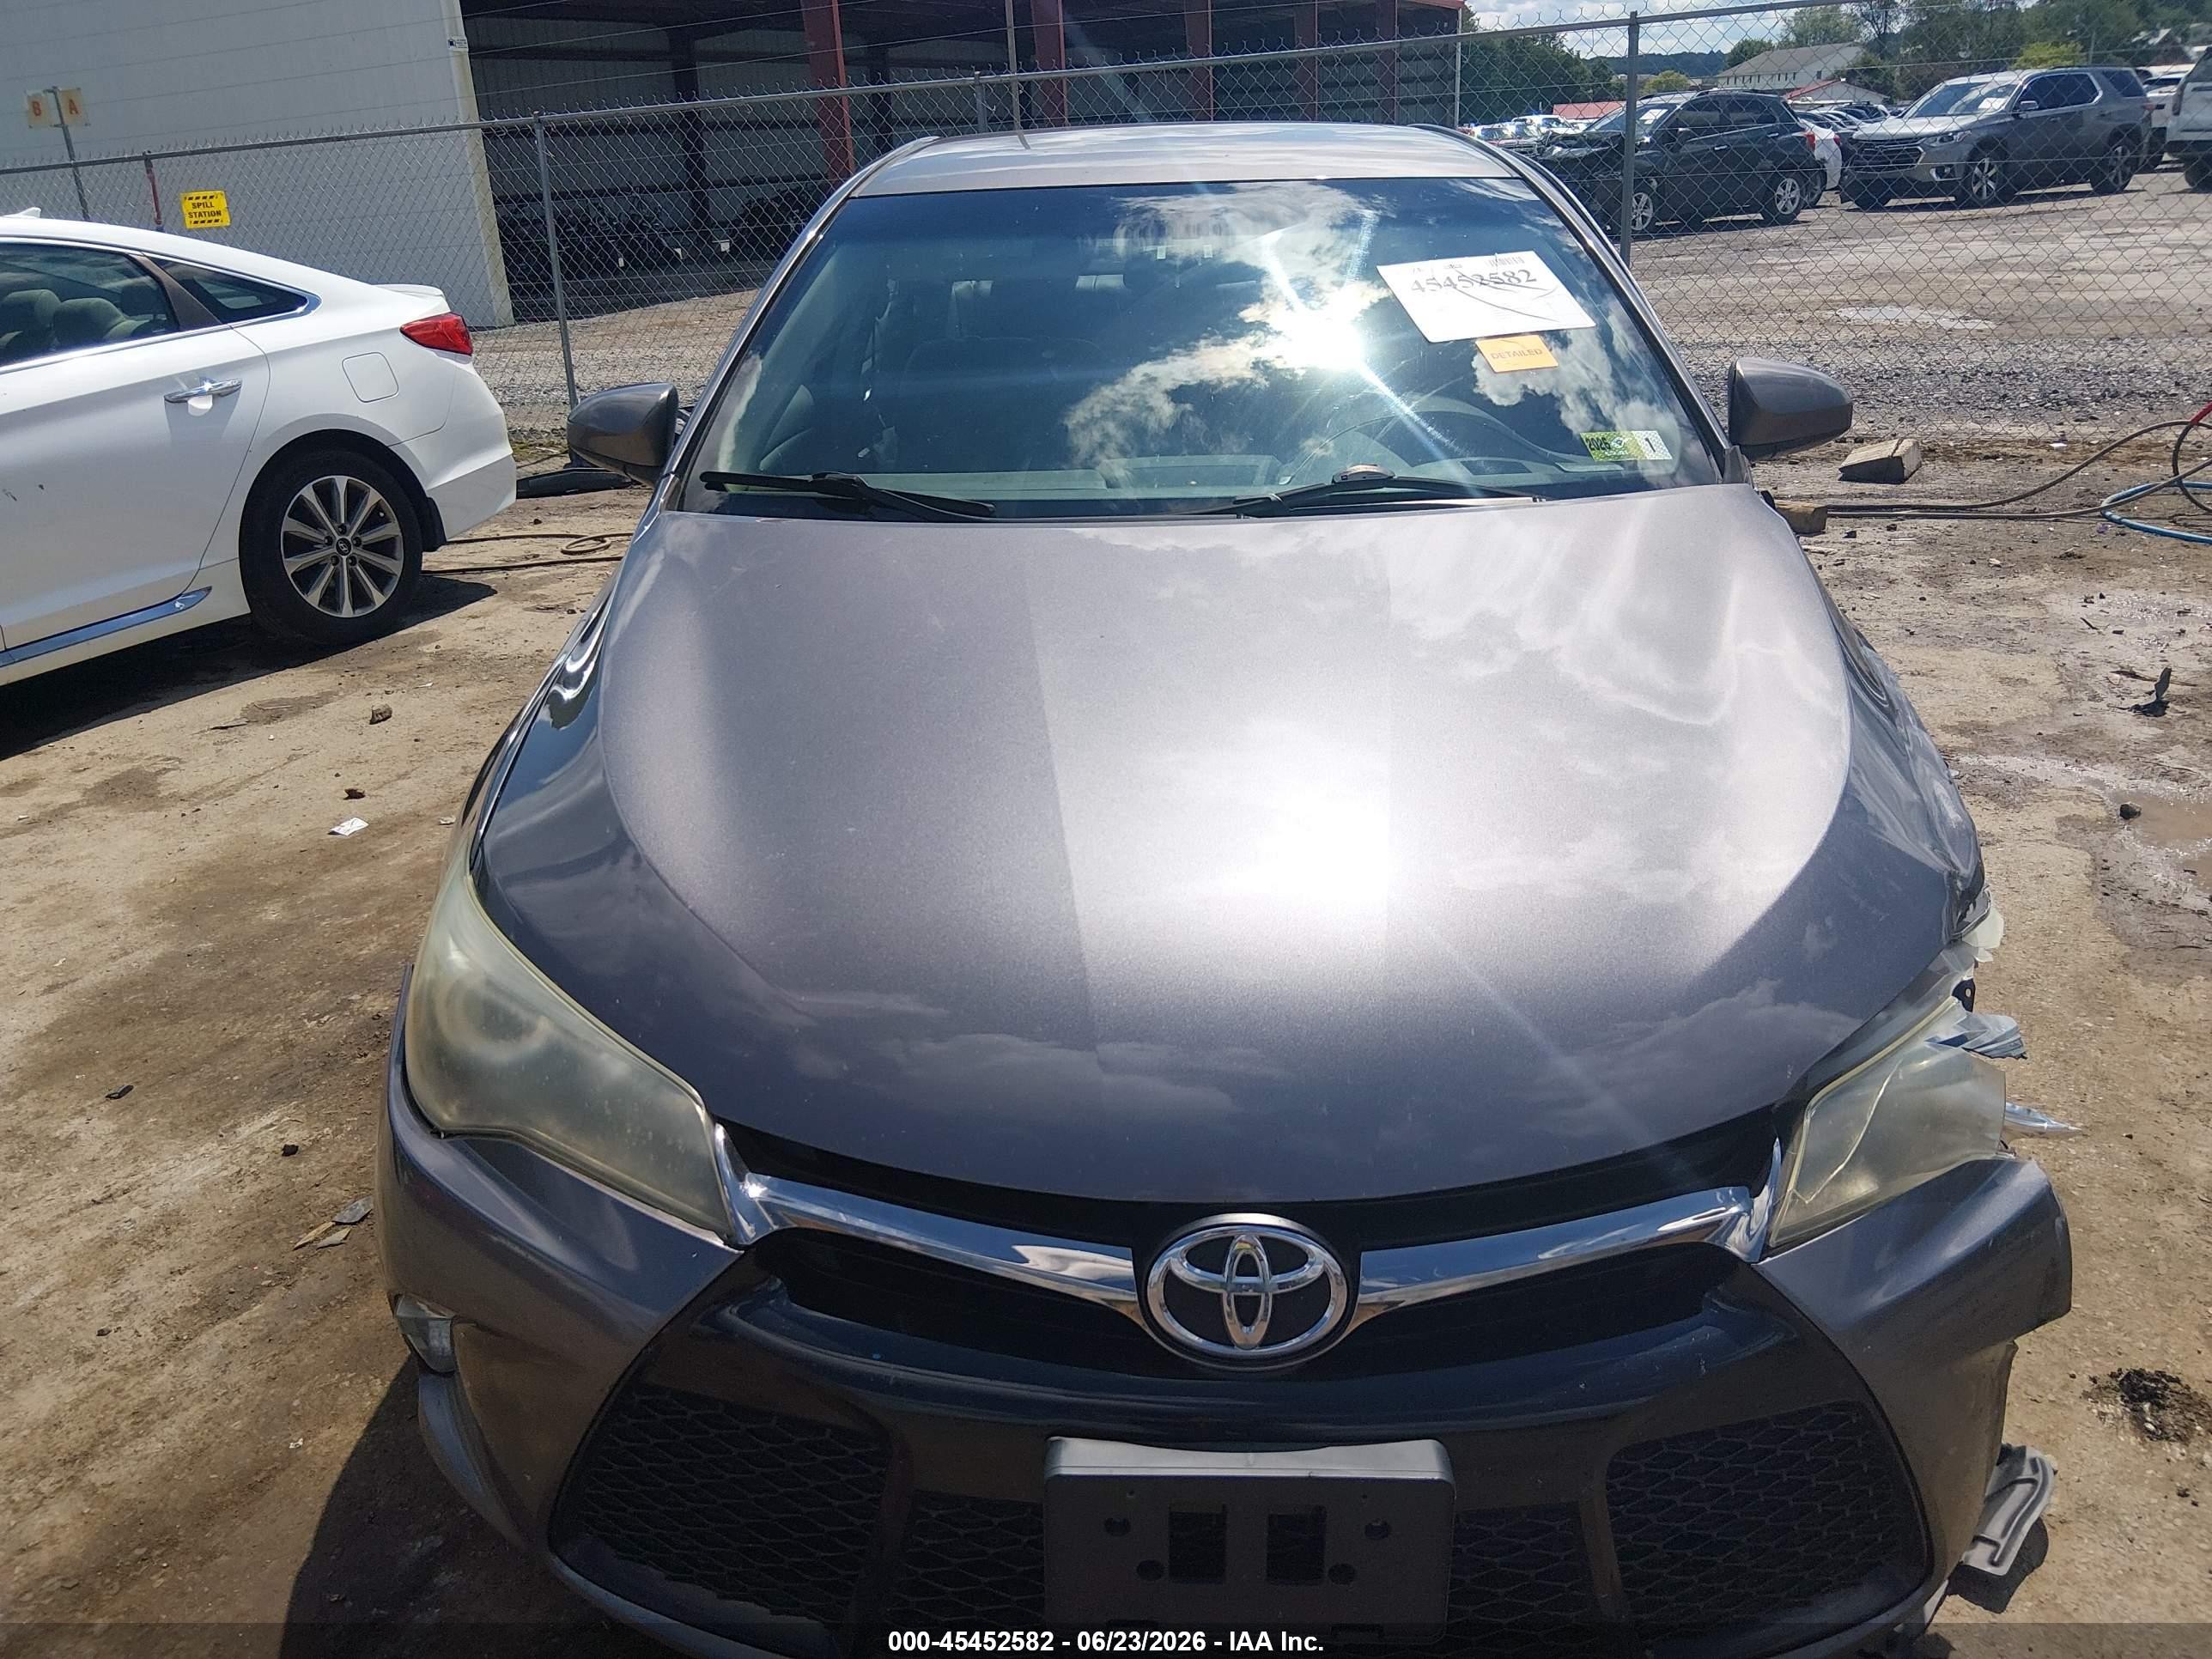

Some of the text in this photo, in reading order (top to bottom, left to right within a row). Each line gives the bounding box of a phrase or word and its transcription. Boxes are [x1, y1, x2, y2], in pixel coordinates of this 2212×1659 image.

[32, 100, 41, 116] B
[69, 99, 79, 114] A
[1411, 269, 1537, 293] 45452582
[1491, 349, 1543, 359] DETAILED
